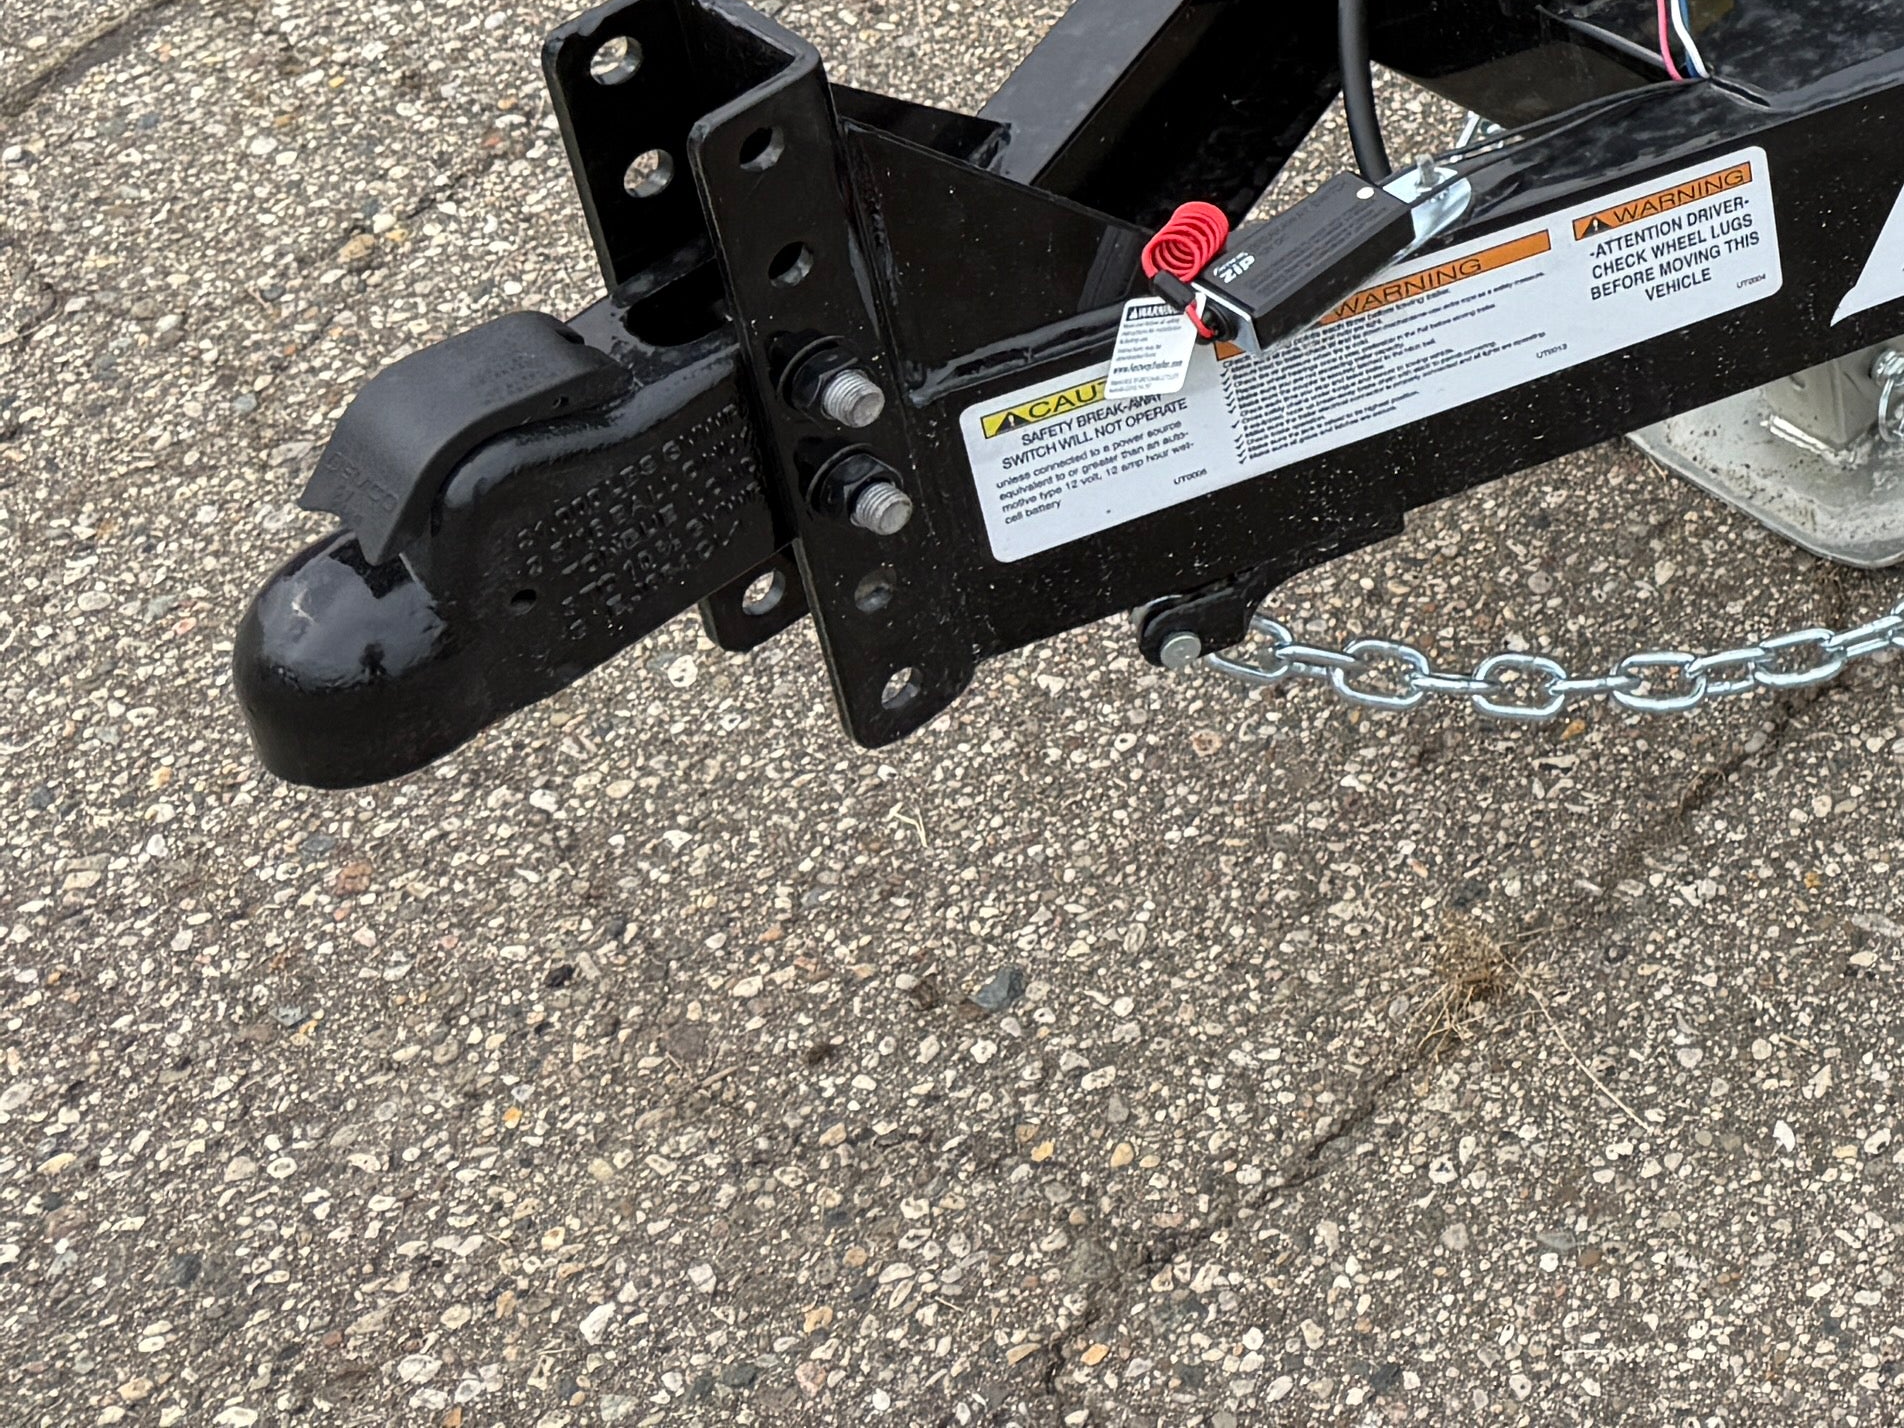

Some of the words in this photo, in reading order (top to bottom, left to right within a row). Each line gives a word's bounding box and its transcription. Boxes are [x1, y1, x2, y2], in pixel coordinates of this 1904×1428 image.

[1590, 217, 1683, 259] -ATTENTION
[1687, 196, 1750, 226] DRIVER-
[1614, 169, 1744, 223] WARNING
[1219, 255, 1256, 284] ZIP
[1591, 267, 1655, 300] BEFORE
[1659, 246, 1721, 277] MOVING
[1724, 231, 1760, 254] THIS
[1592, 249, 1648, 280] CHECK
[1651, 229, 1707, 259] WHEEL
[1711, 214, 1753, 239] LUGS
[1335, 258, 1482, 318] WARNING
[1645, 268, 1712, 301] VEHICLE
[1002, 443, 1056, 469] SWITCH
[1060, 432, 1093, 451] WILL
[1095, 421, 1122, 439] NOT
[1126, 398, 1188, 427] OPERATE
[1022, 420, 1072, 445] SAFETY
[1077, 394, 1163, 427] BREAK-AWAY
[996, 472, 1031, 489] unless
[1034, 451, 1088, 477] connected
[1090, 448, 1101, 458] to
[1103, 445, 1110, 453] a
[1112, 434, 1144, 451] power
[1146, 420, 1182, 438] source
[999, 477, 1053, 501] equivalent
[1055, 472, 1066, 482] to
[1068, 468, 1079, 478] or
[1081, 455, 1118, 474] greater
[1121, 445, 1145, 458] than
[1146, 441, 1160, 451] an
[1162, 432, 1189, 445] auto-
[1002, 495, 1037, 513] motive
[1039, 486, 1062, 503] type
[1066, 478, 1078, 490] 12
[1105, 466, 1118, 477] 12
[1121, 459, 1144, 474] amp
[1145, 449, 1170, 462] hour
[1004, 512, 1023, 524] cell
[1025, 500, 1062, 518] battery
